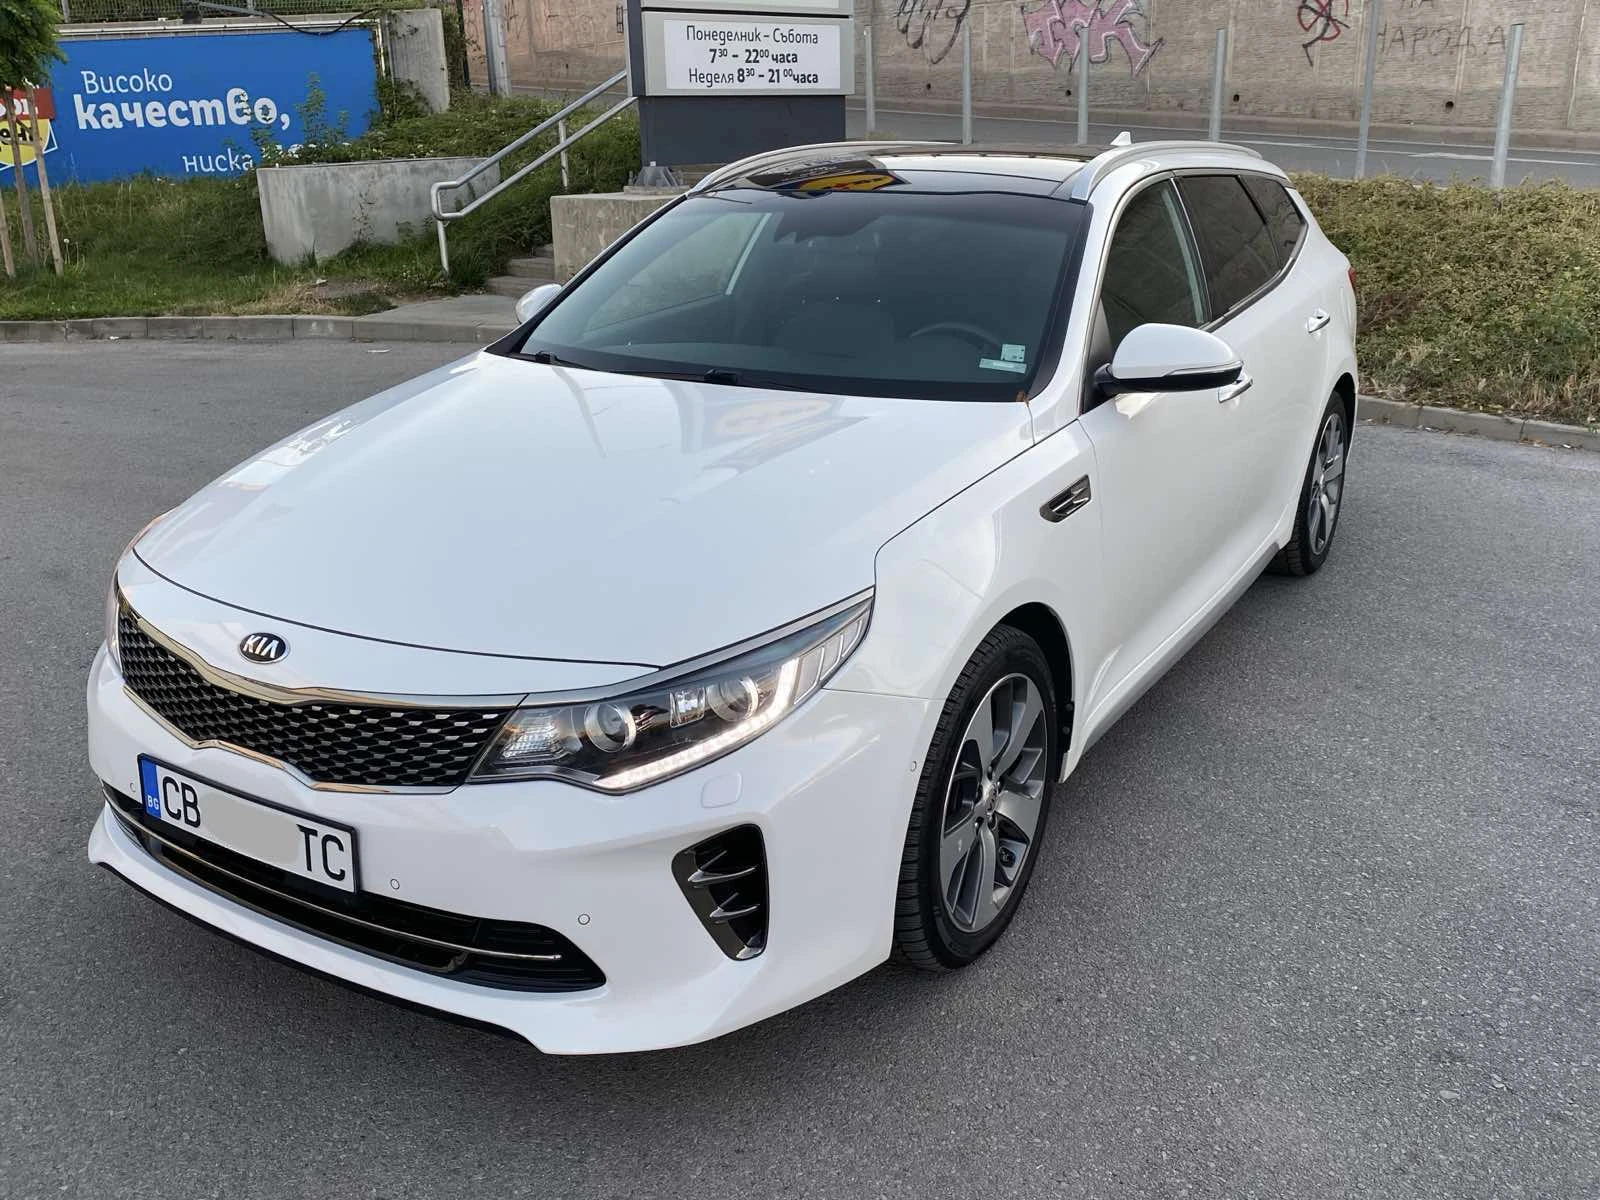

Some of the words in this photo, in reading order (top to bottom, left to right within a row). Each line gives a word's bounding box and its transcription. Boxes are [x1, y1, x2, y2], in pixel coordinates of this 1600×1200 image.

[686, 25, 761, 45] Понеделник
[773, 28, 818, 44] Събота
[771, 53, 798, 64] часа
[81, 67, 173, 95] Високо
[689, 68, 735, 88] Неделя
[792, 73, 819, 84] часа
[73, 87, 291, 131] качество,
[182, 147, 255, 173] ниска
[242, 634, 280, 659] KIA
[147, 794, 160, 810] BG
[162, 776, 201, 828] CB
[296, 823, 346, 882] TC
